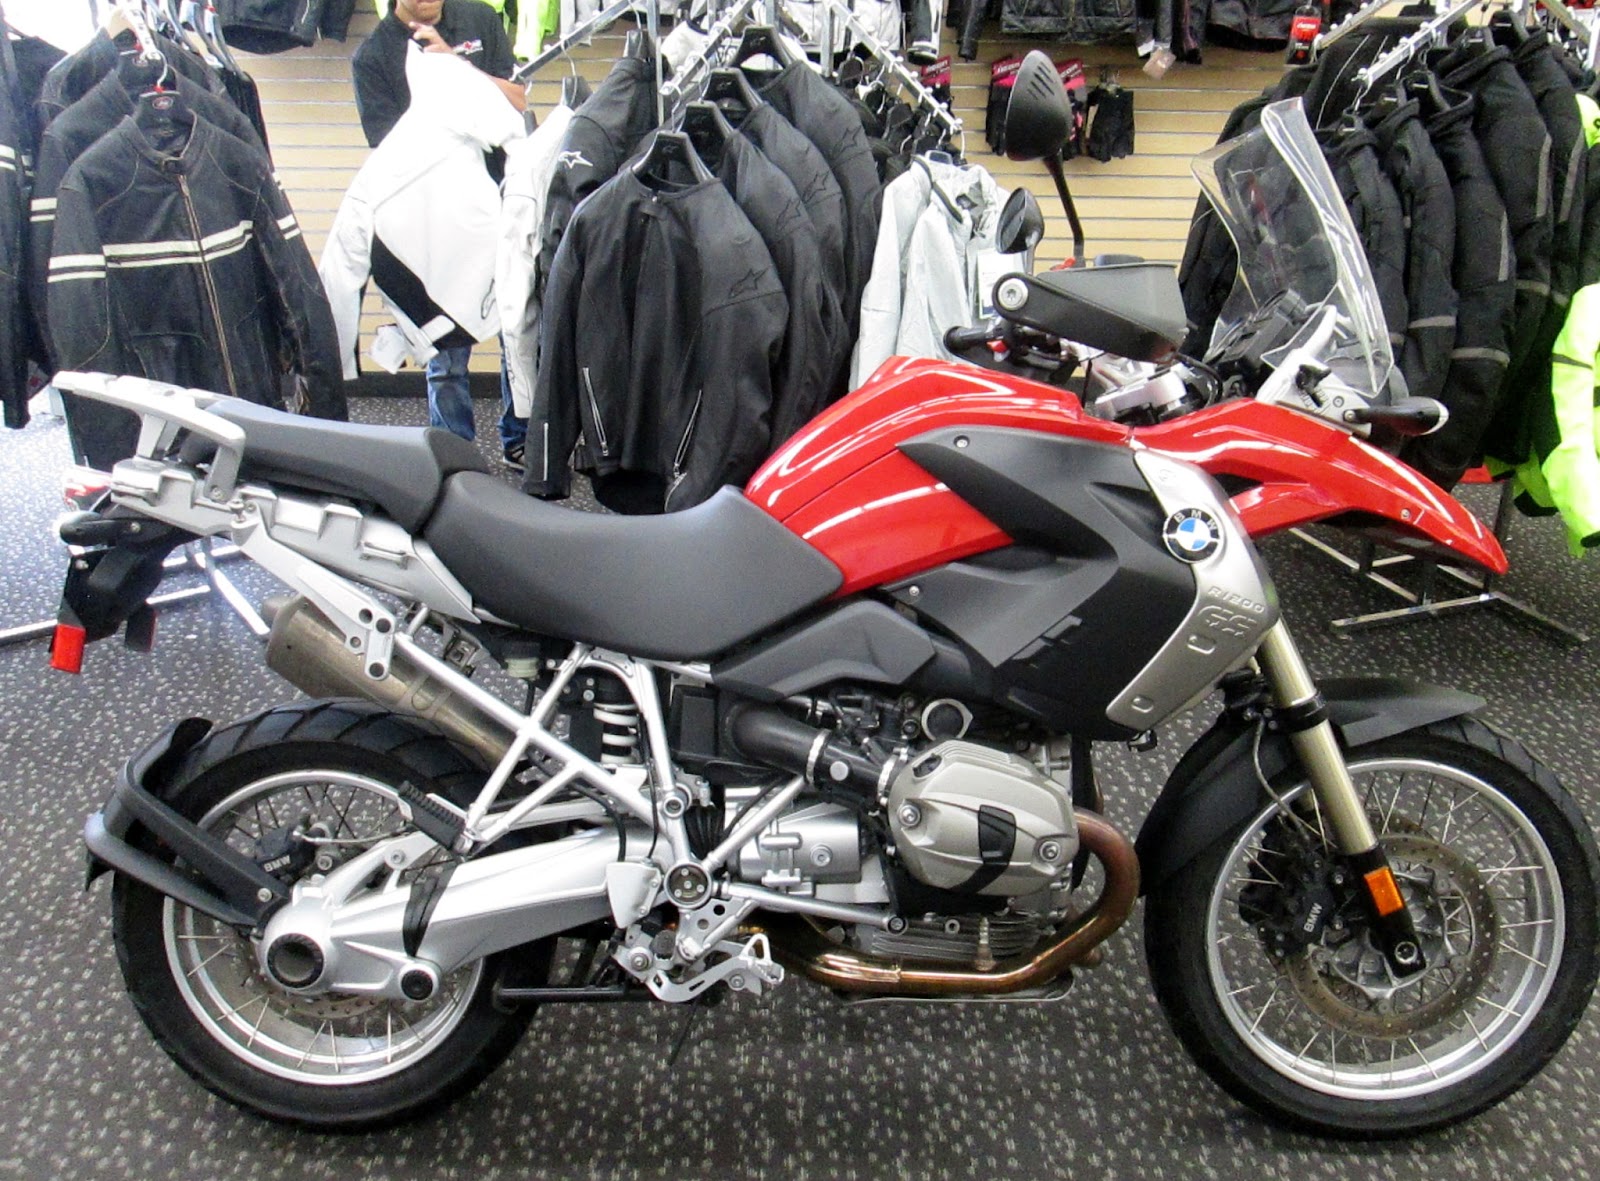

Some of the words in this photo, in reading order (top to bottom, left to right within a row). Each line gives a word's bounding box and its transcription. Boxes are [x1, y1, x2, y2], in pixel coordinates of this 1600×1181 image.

[1173, 509, 1218, 530] BMW
[1207, 585, 1265, 614] R1200
[263, 855, 291, 872] BMW
[1304, 902, 1322, 932] BMW
